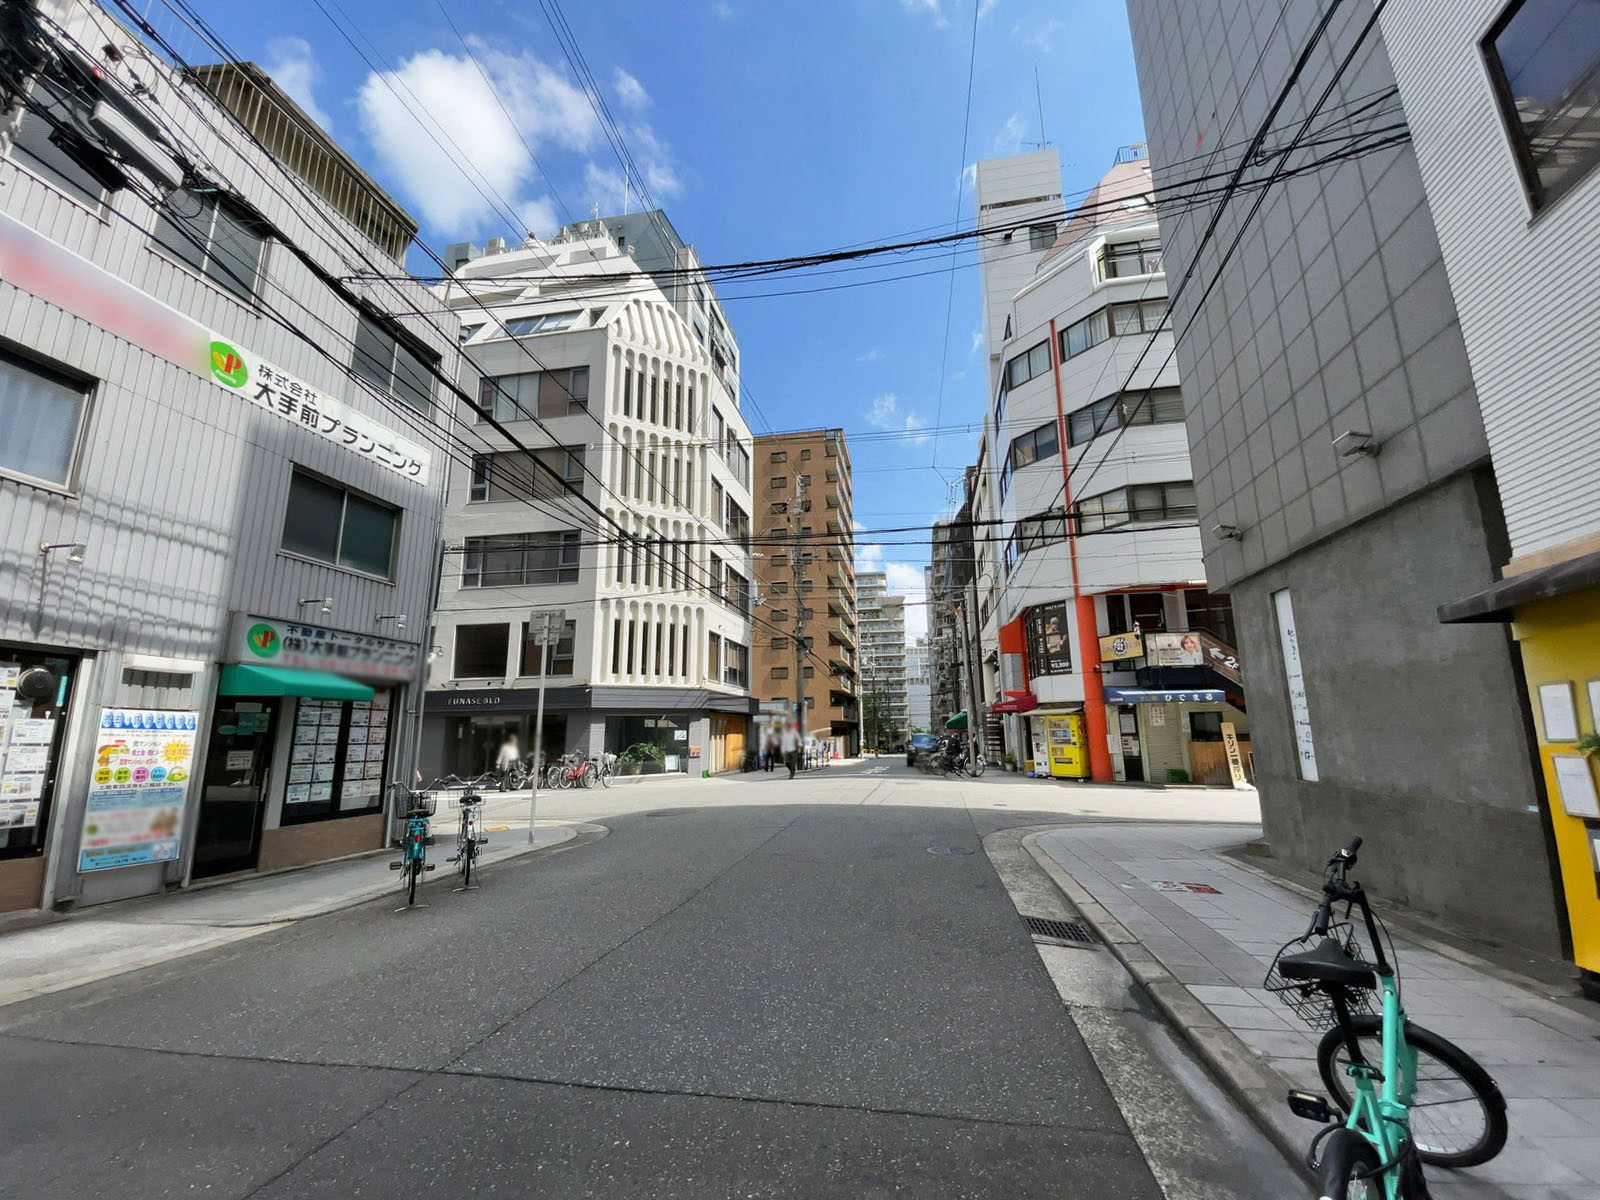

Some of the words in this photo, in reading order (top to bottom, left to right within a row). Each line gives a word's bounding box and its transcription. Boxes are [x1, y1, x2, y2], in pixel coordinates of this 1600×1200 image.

[258, 364, 318, 406] 株式会社
[253, 381, 423, 477] 大手前プランニング
[286, 624, 417, 652] 不動産トータルサポート
[1223, 656, 1240, 670] 2F
[447, 697, 481, 705] FUNASE
